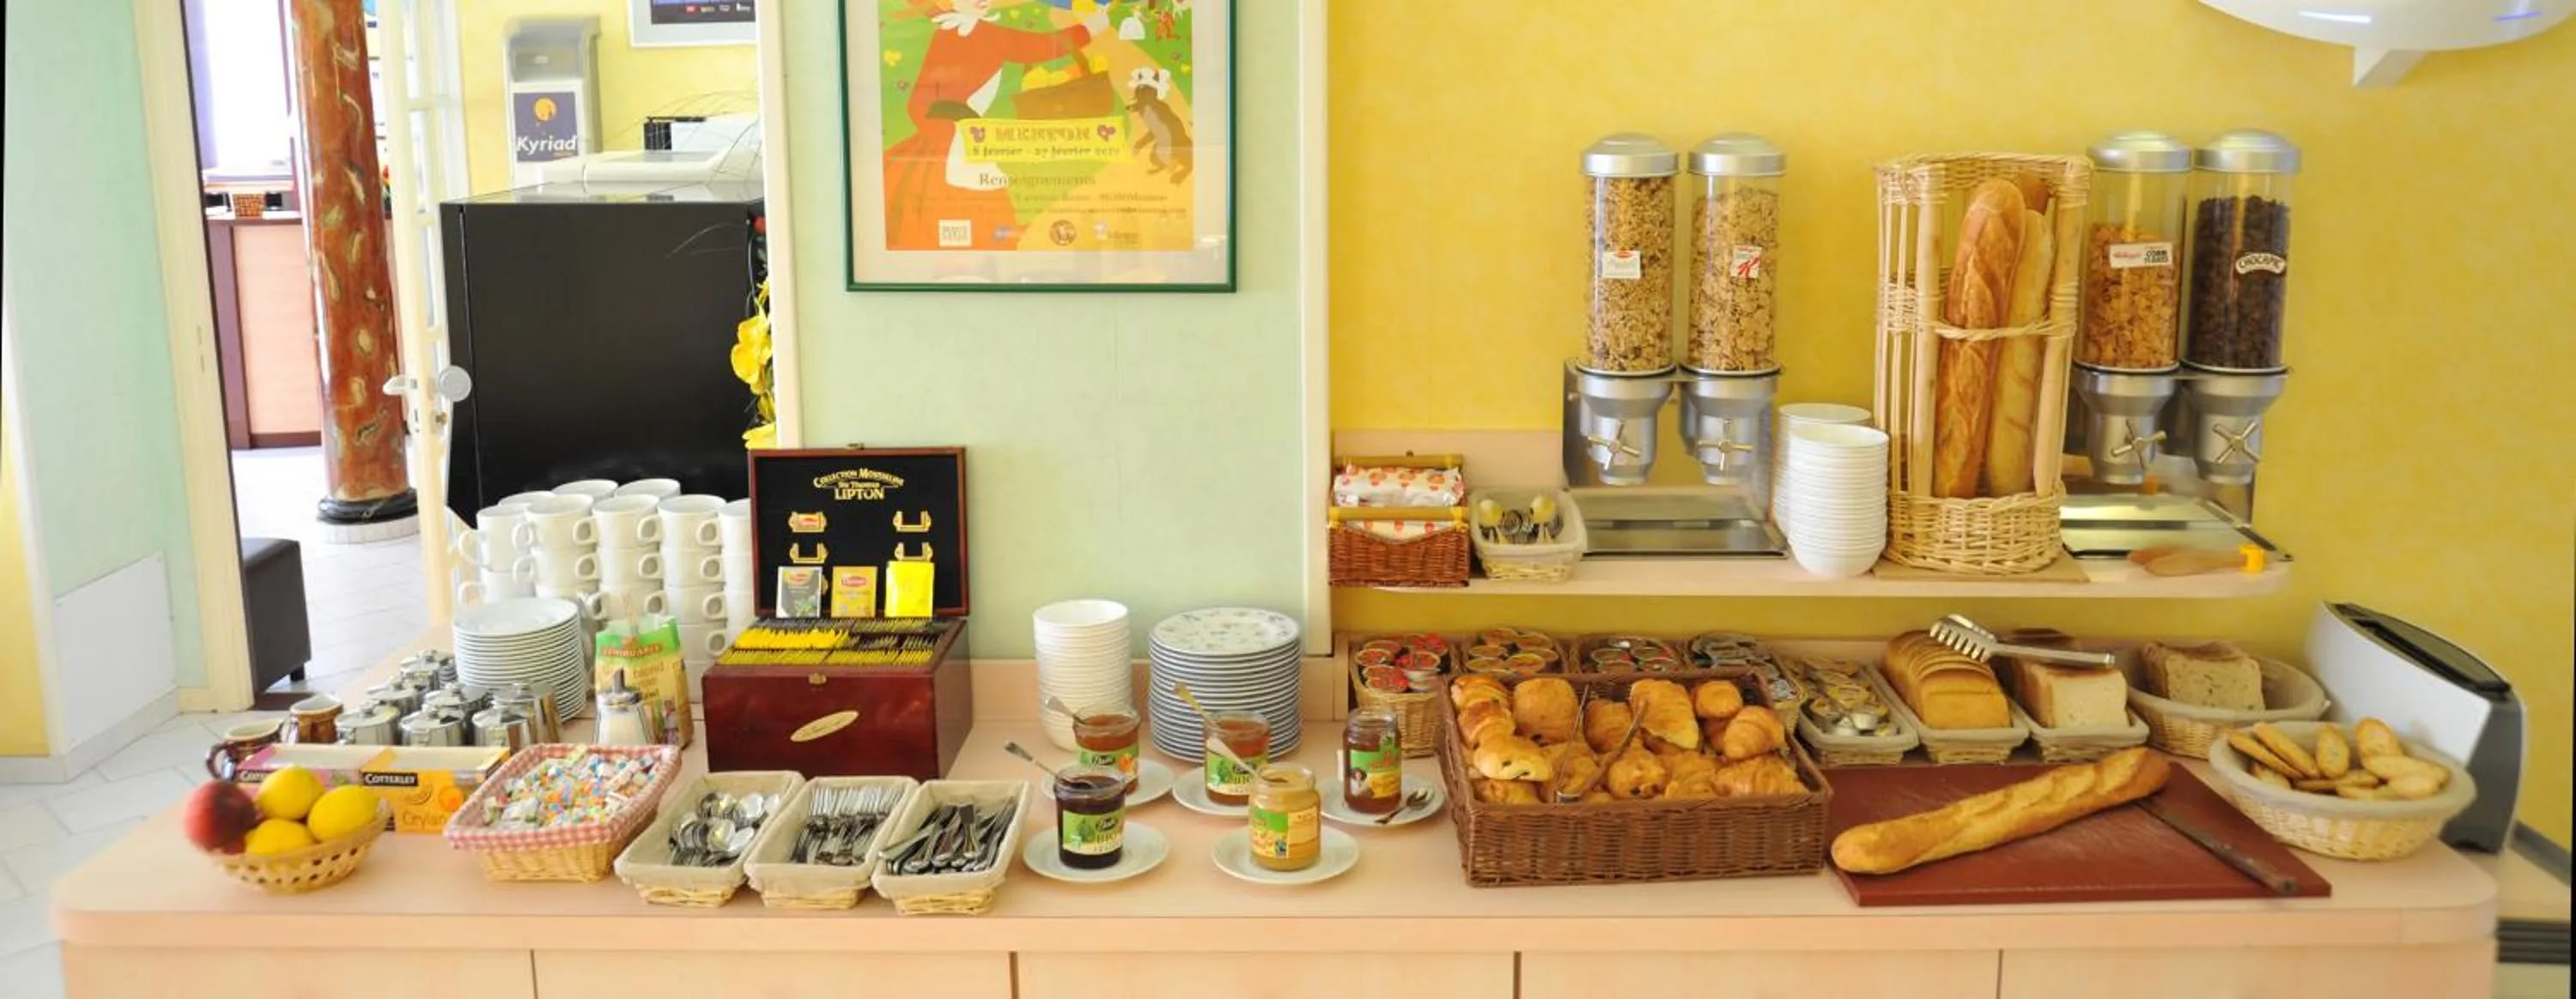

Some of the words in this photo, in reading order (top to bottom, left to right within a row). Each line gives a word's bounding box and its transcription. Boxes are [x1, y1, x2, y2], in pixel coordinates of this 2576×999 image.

[515, 135, 578, 155] Kyriad
[2239, 255, 2283, 269] CHOCAPIC
[835, 487, 885, 500] LIPTON
[365, 773, 416, 784] COTTERLEY
